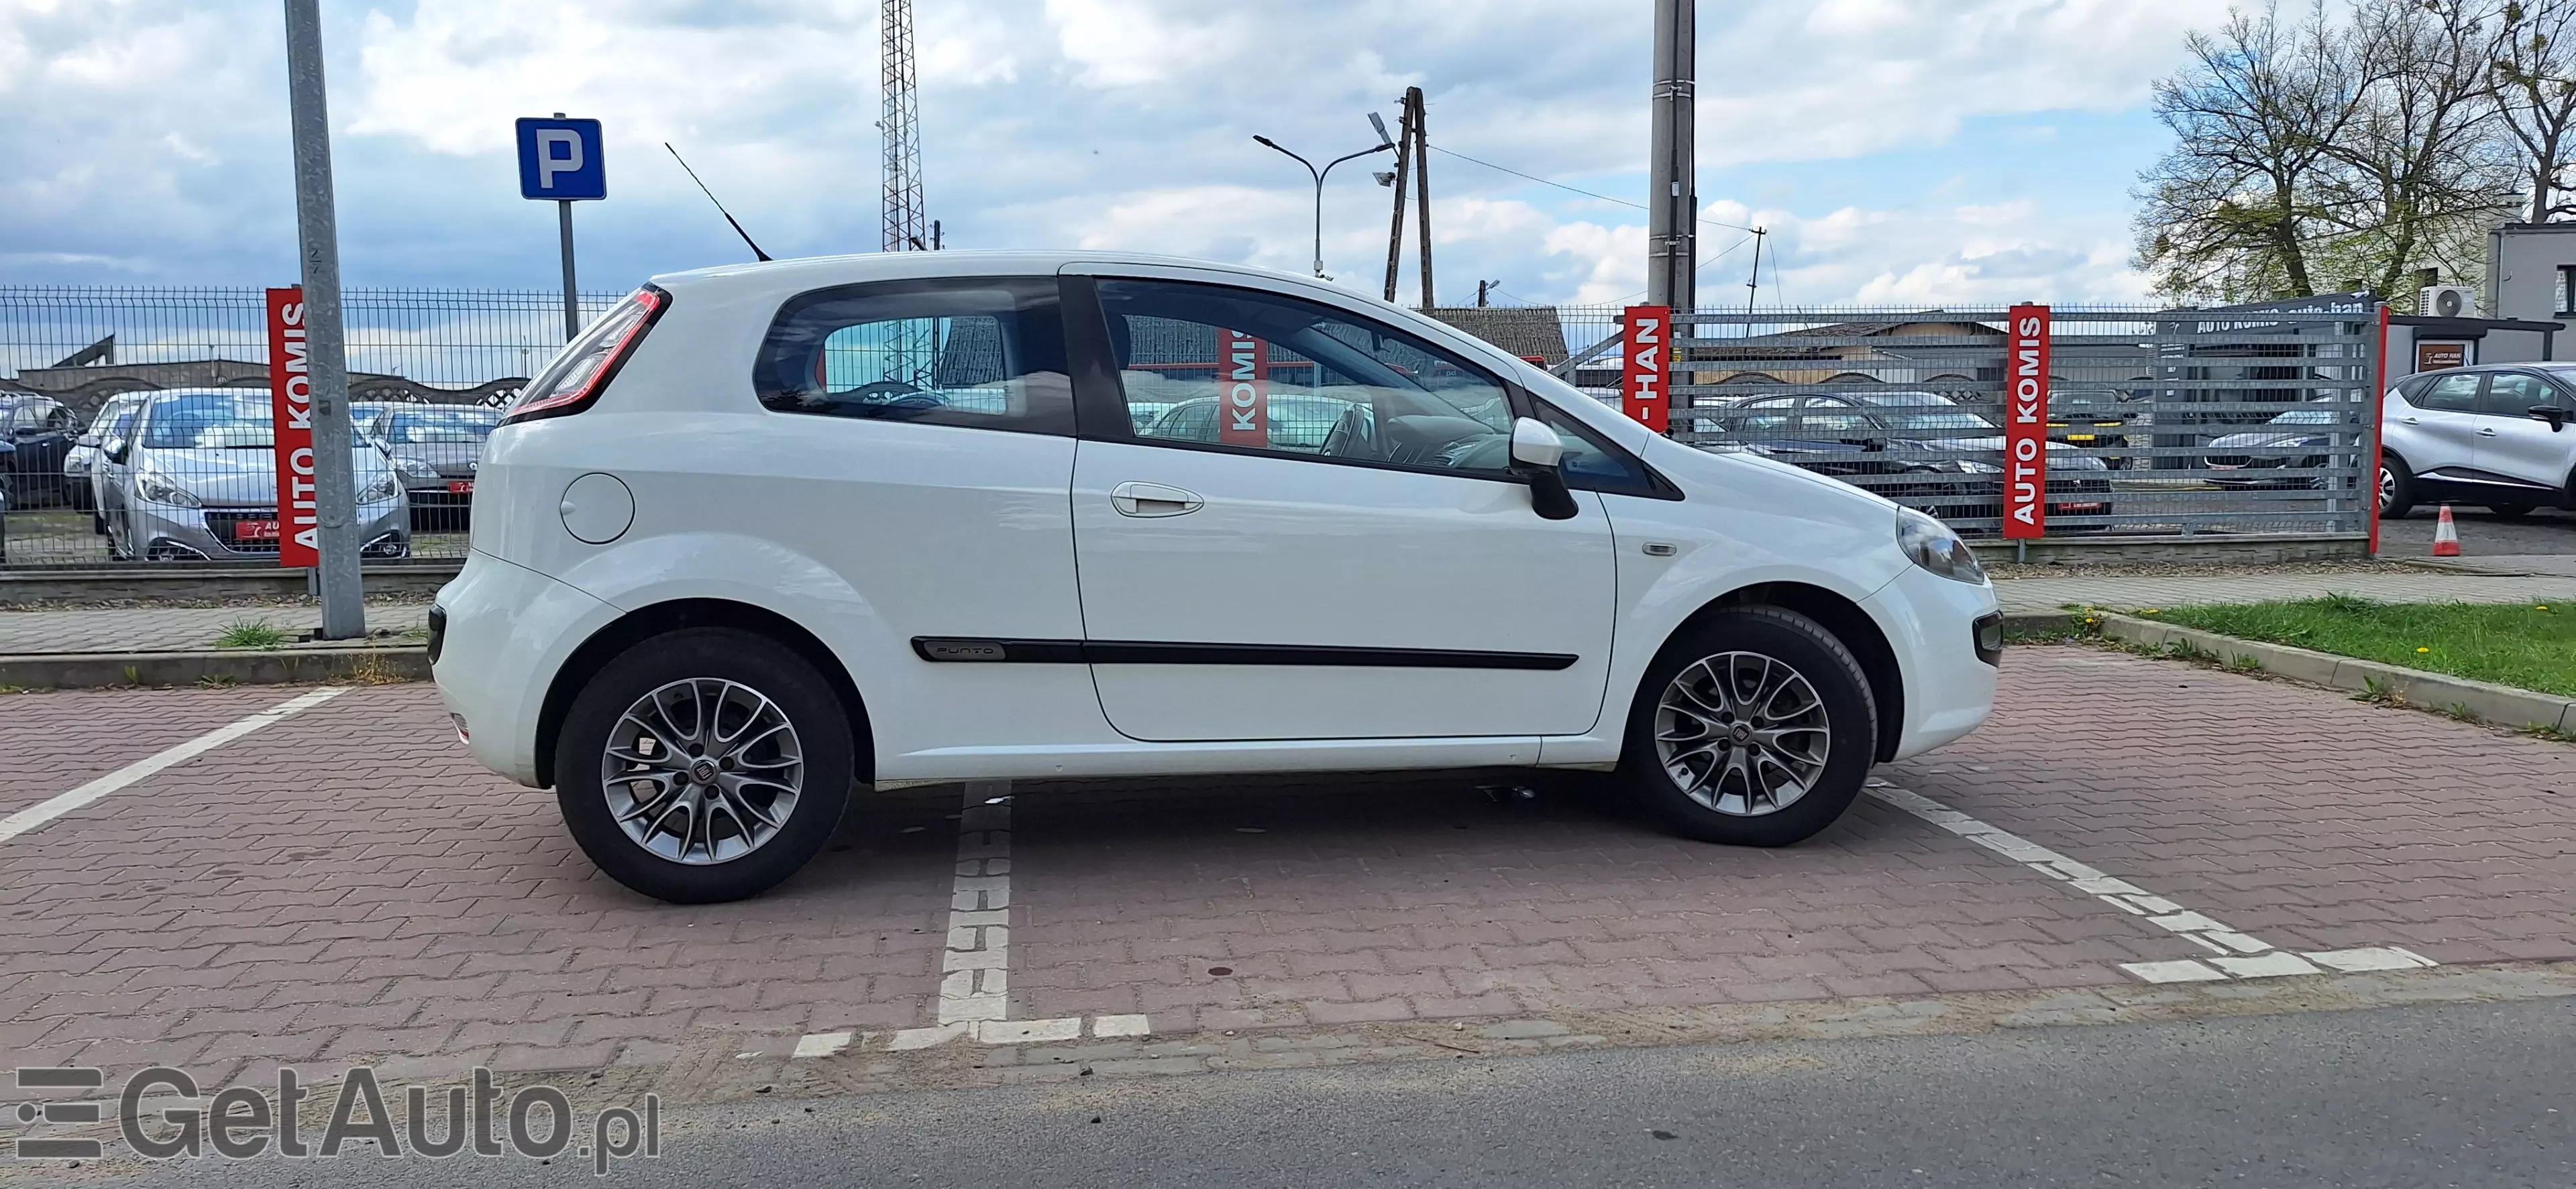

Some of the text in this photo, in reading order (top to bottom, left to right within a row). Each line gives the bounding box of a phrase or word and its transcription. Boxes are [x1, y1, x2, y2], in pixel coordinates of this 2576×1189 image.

[536, 129, 584, 188] P
[1635, 319, 1658, 399] HAN
[282, 303, 319, 550] AUTO KOMIS
[2014, 317, 2041, 525] AUTO KOMIS
[264, 522, 280, 530] AU
